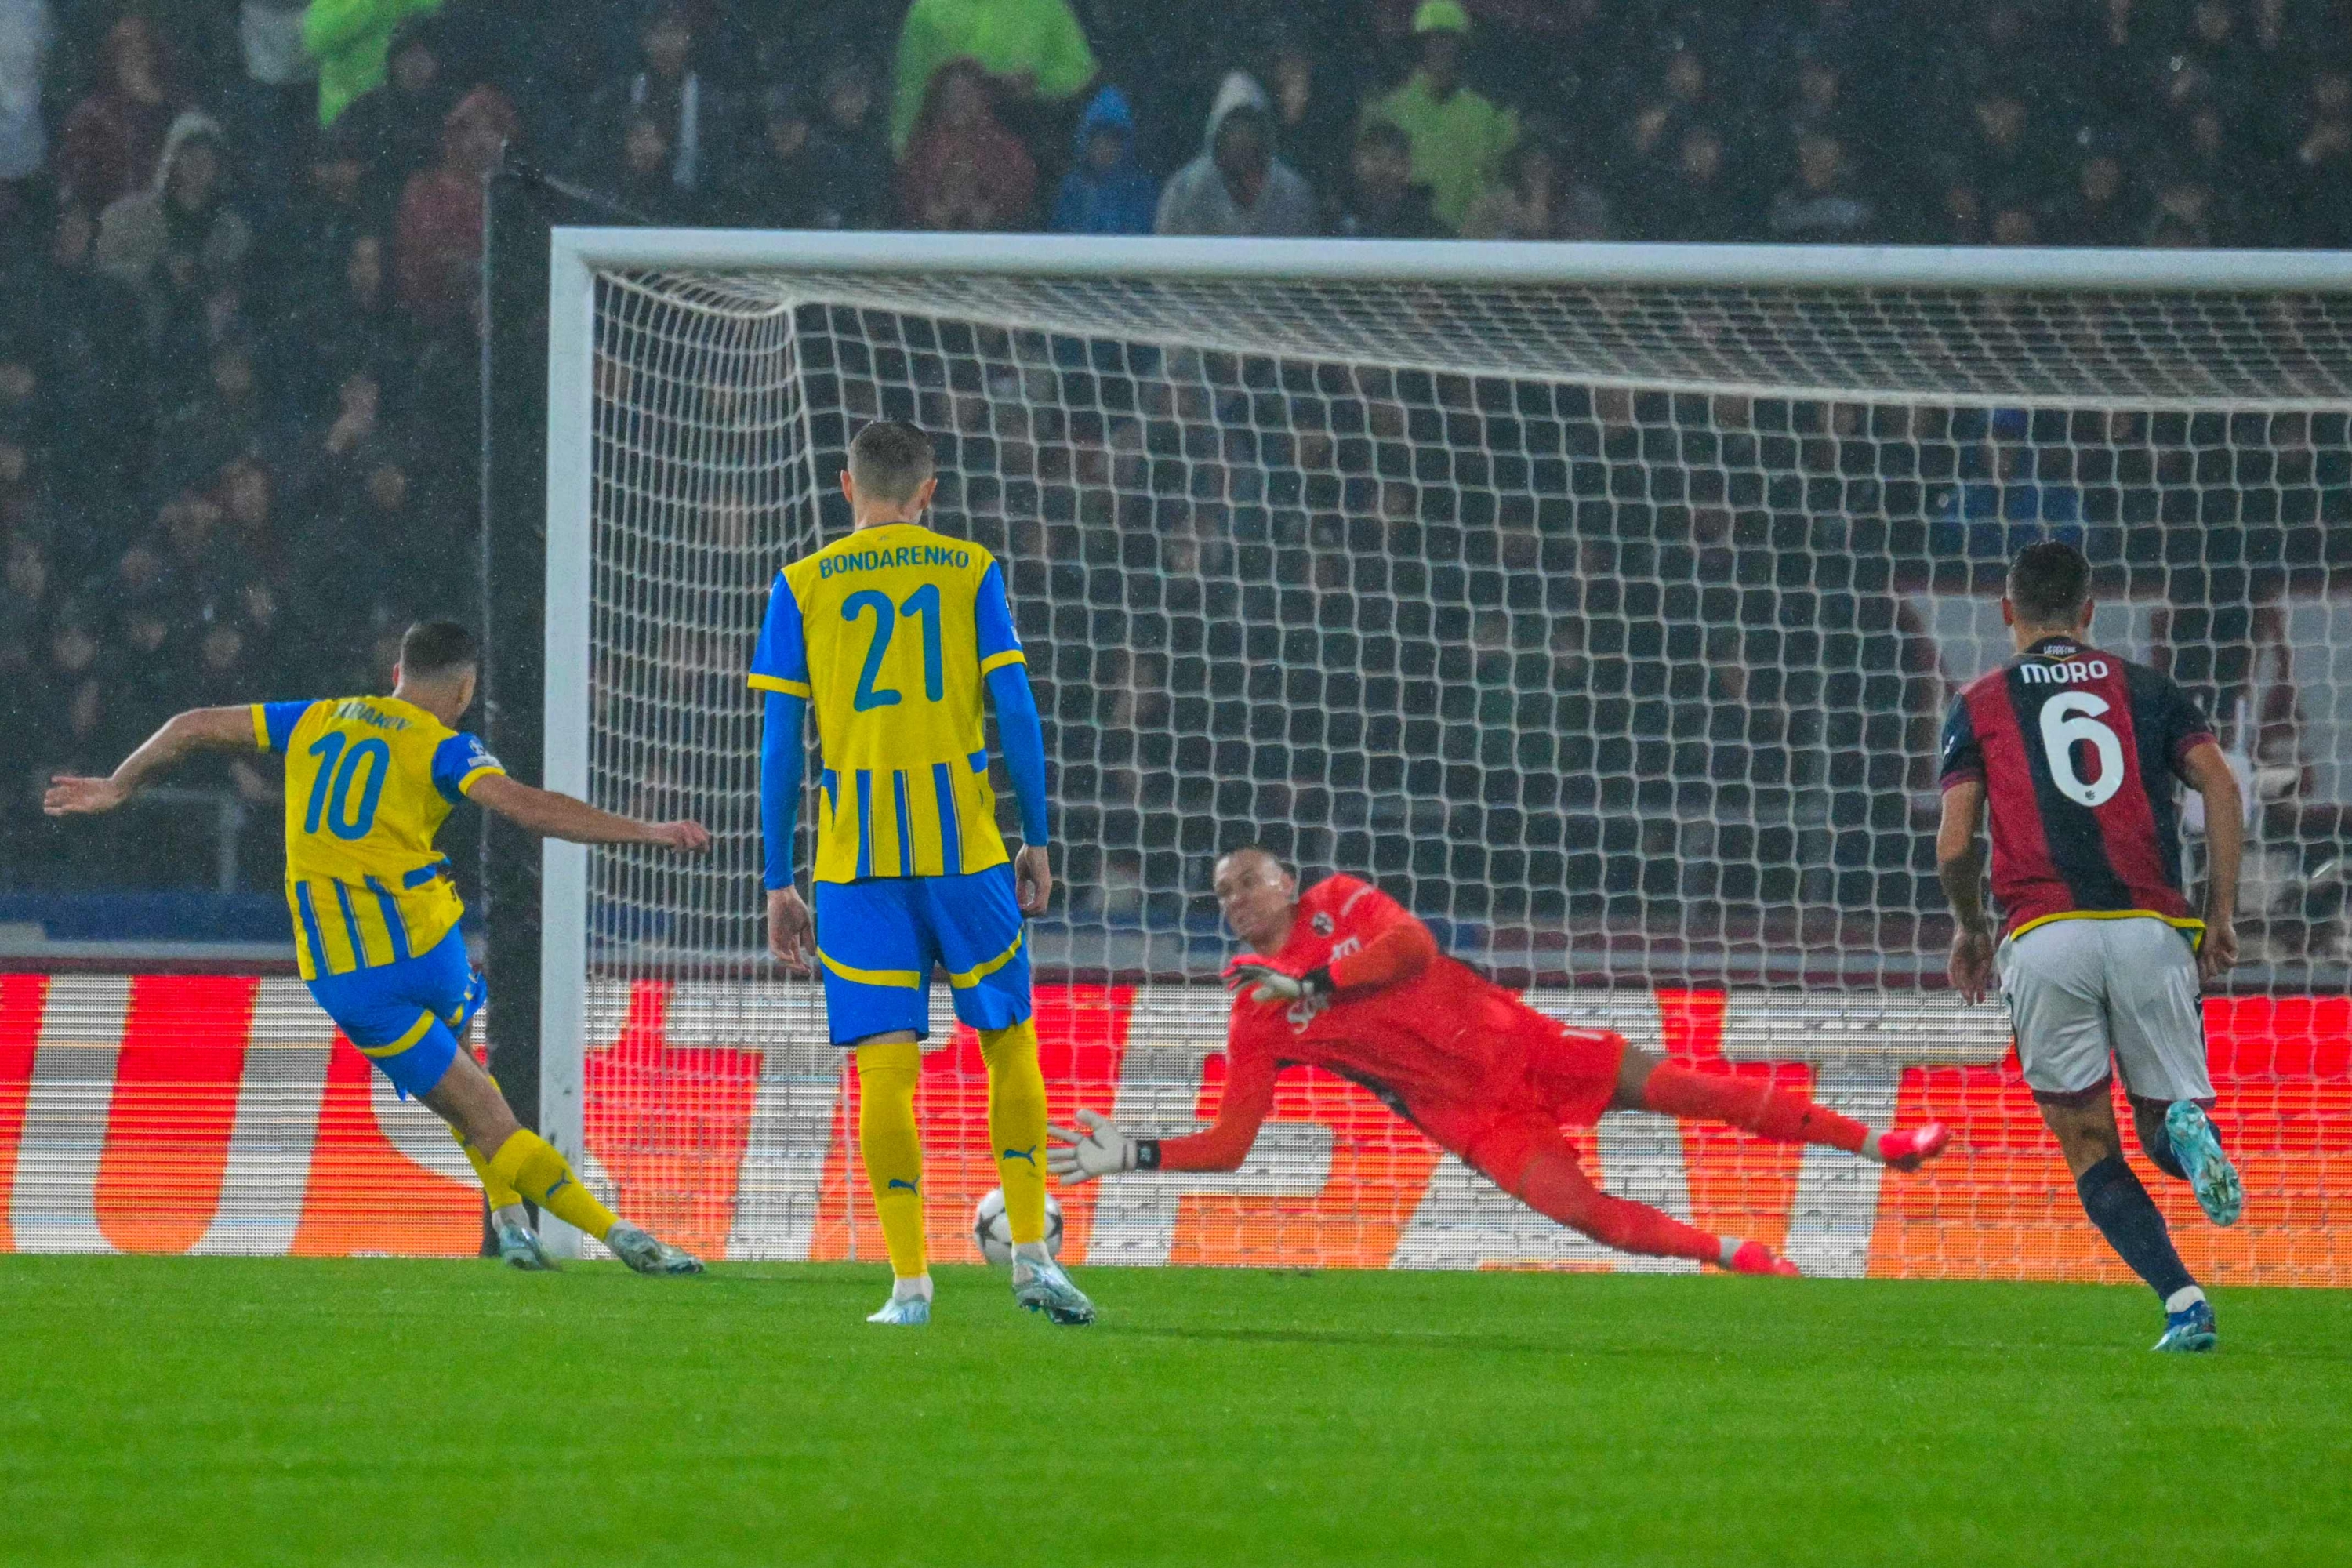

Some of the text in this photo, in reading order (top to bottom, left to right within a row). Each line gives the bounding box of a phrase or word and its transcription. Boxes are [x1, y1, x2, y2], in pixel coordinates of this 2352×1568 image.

[819, 545, 969, 579] BONDARENKO
[840, 583, 944, 713] 21
[2020, 659, 2109, 684] MORO
[304, 730, 390, 840] 10
[2039, 691, 2125, 808] 6
